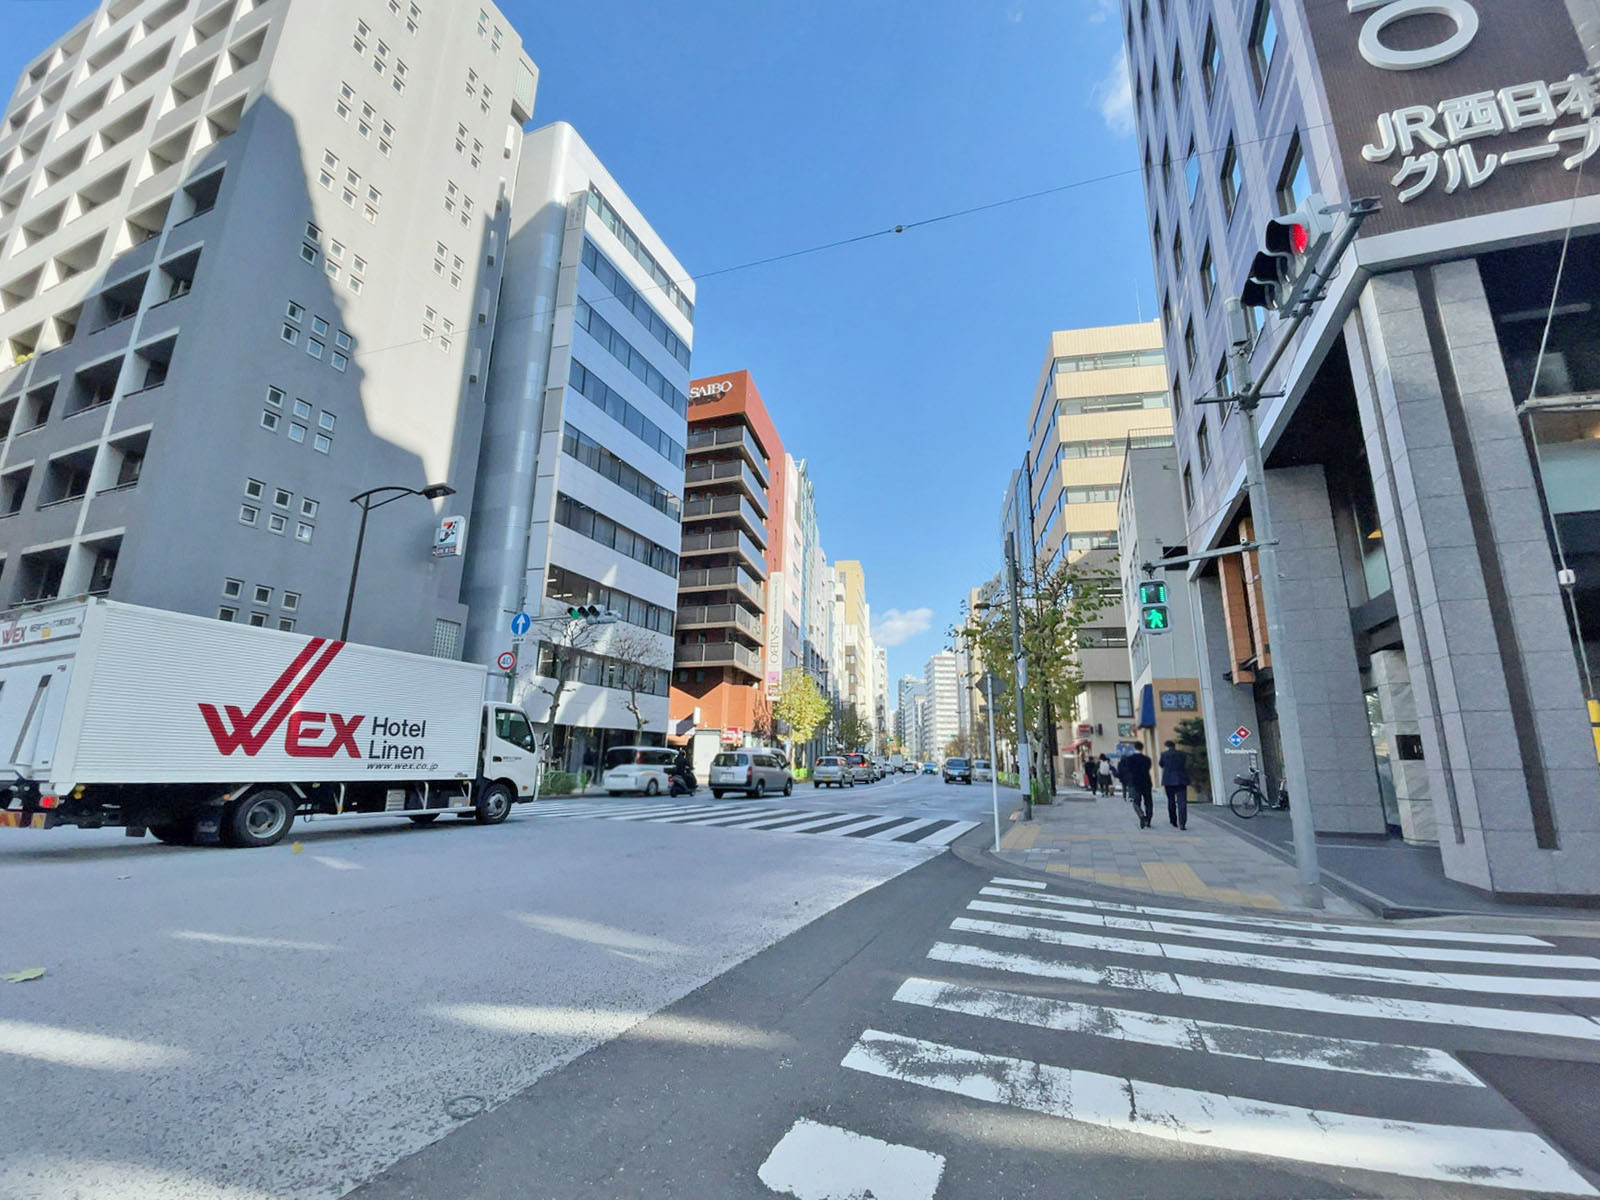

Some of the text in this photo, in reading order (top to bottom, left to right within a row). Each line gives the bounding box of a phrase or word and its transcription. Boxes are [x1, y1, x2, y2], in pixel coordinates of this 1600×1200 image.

[1361, 73, 1600, 163] JR西日本
[689, 380, 733, 399] SAIBO
[2, 621, 27, 645] WEX
[769, 627, 780, 664] SAIBO
[501, 655, 512, 666] 40
[198, 637, 366, 759] WEX
[372, 716, 427, 738] Hotel
[369, 739, 425, 760] Linen
[366, 761, 439, 771] www.wex.co.jp
